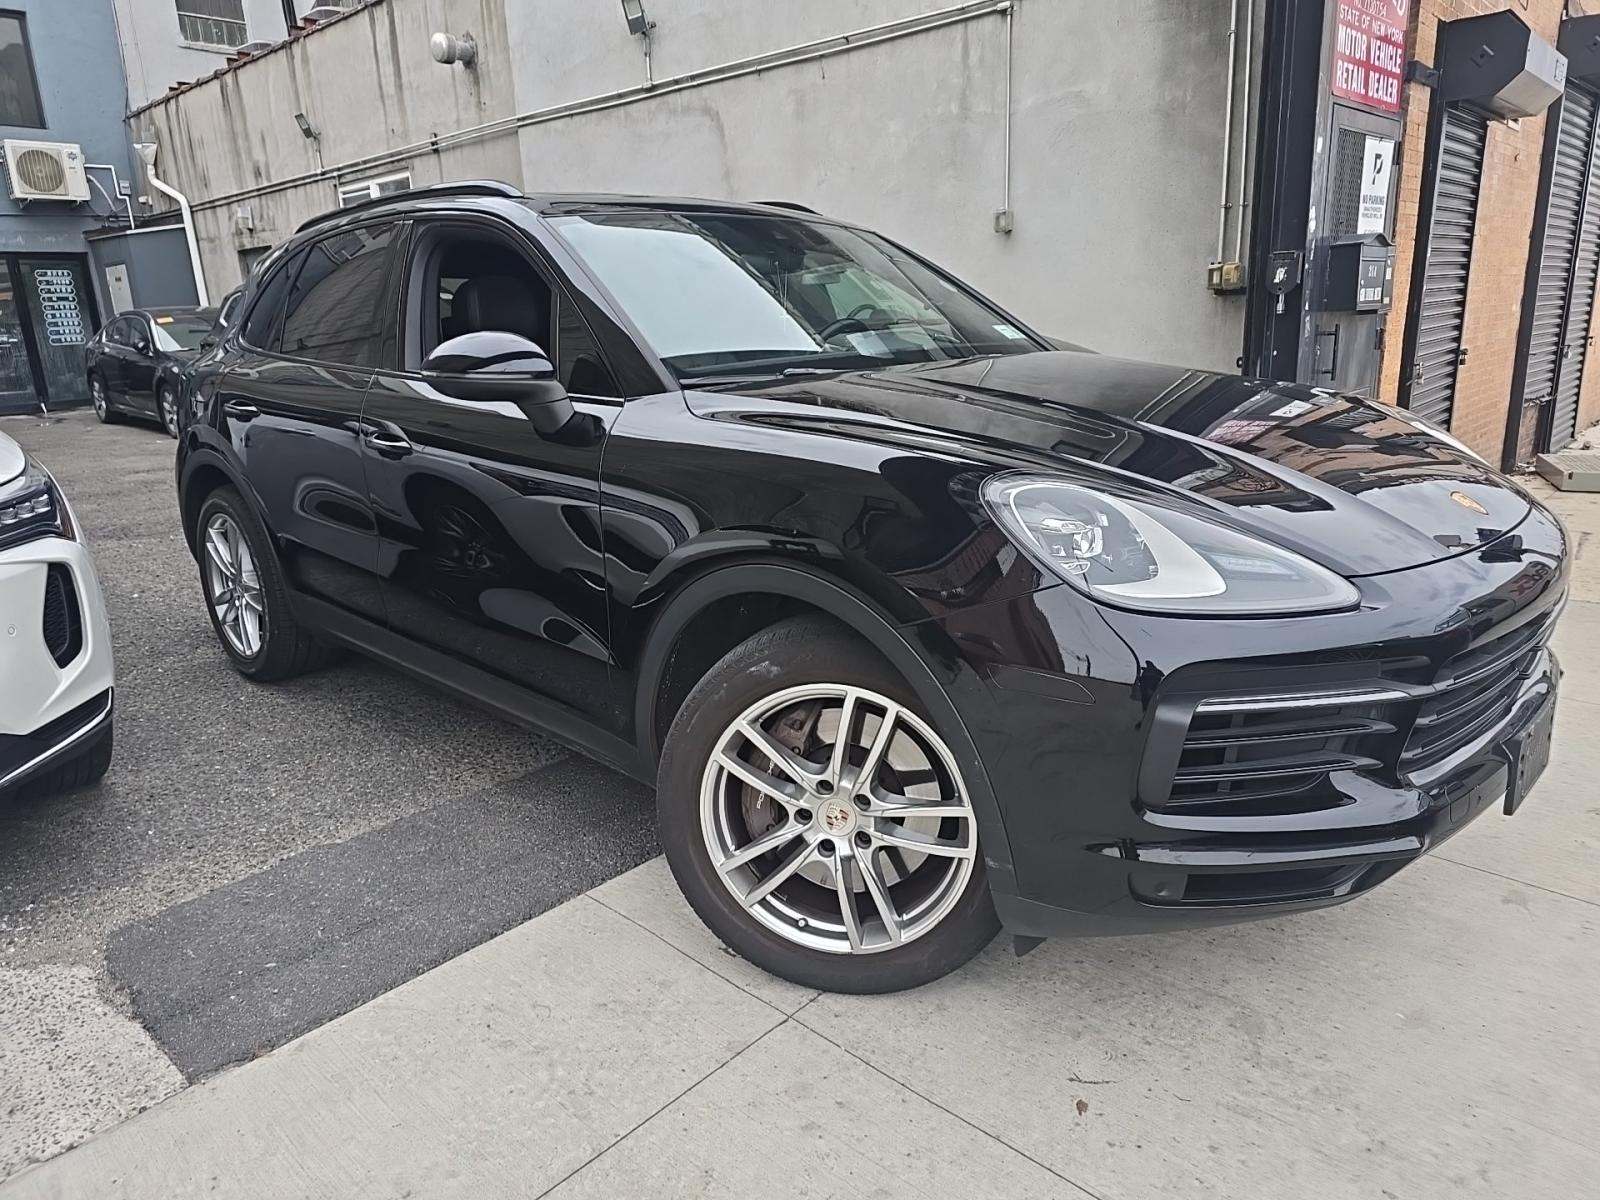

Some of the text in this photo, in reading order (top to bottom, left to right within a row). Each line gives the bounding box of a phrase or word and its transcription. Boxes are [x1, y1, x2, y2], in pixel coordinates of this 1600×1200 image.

[1339, 4, 1404, 45] STATE OF NEW YORK
[1337, 23, 1402, 74] MOTOR VEHICLE
[1336, 59, 1398, 105] RETAIL DEALER
